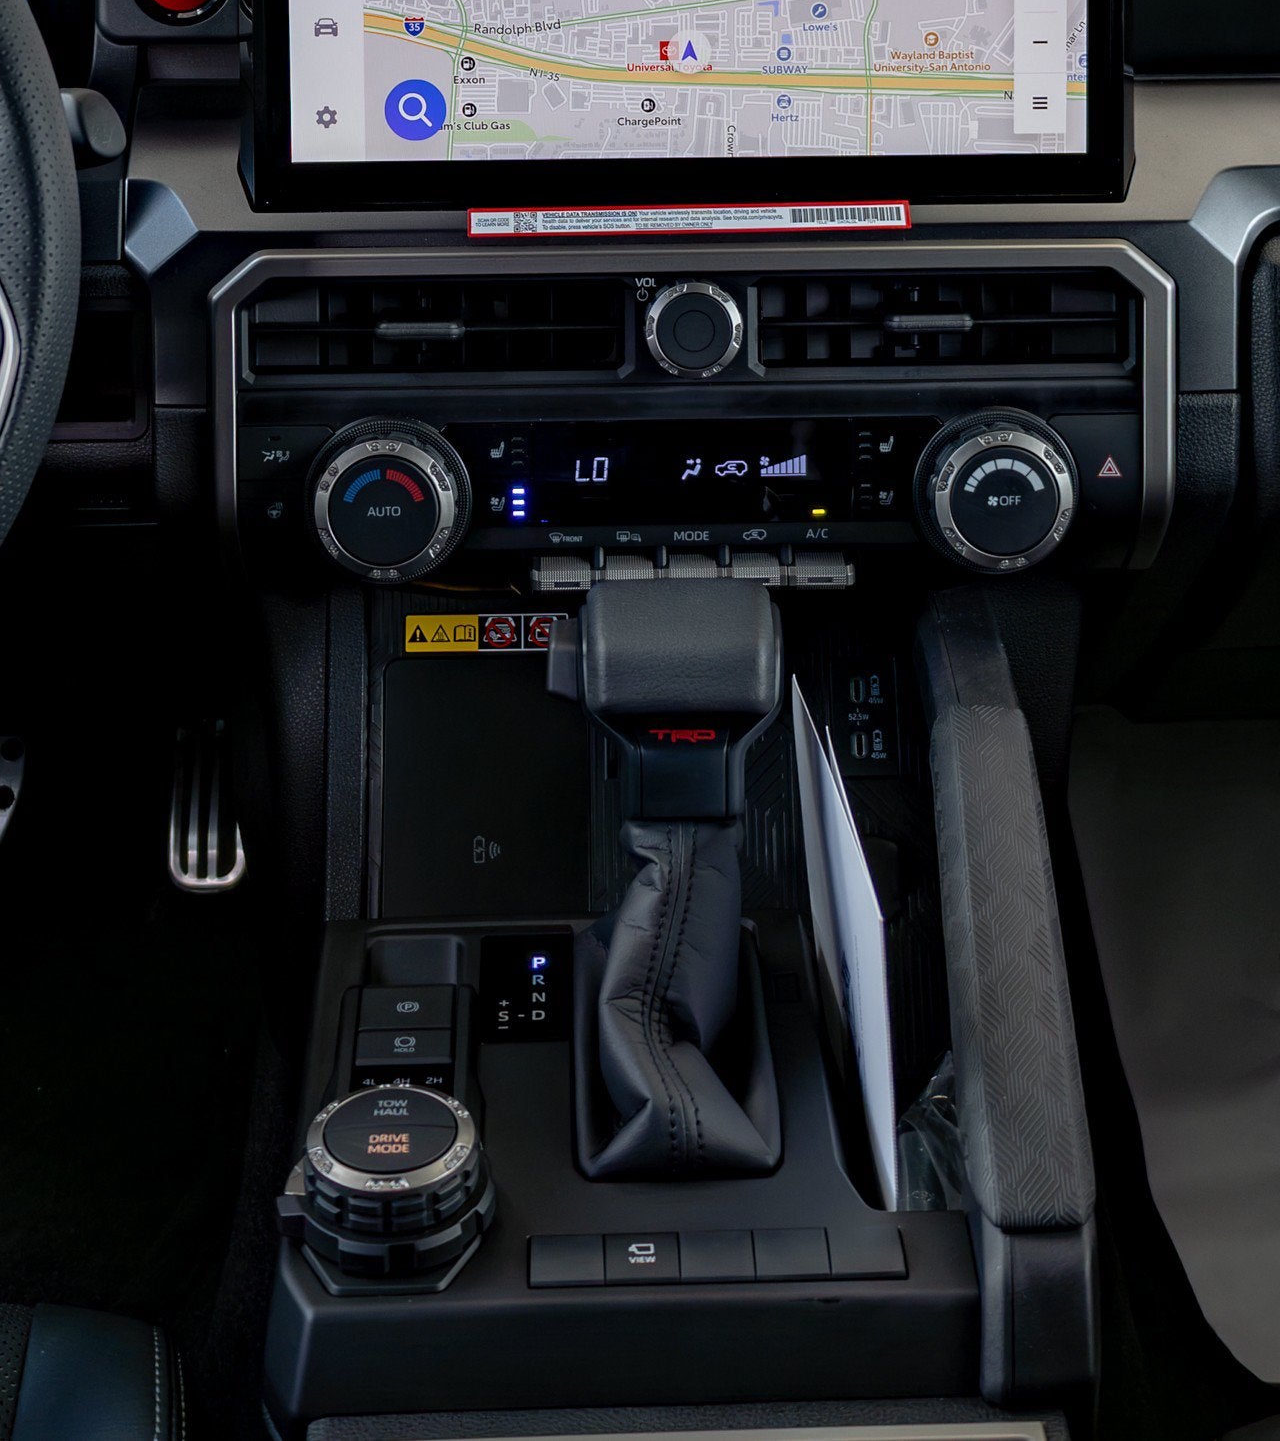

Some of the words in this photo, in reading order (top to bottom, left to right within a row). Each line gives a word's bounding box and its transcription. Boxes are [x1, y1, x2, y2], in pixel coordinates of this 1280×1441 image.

[408, 23, 421, 32] 35
[474, 22, 533, 36] Randolph
[535, 19, 562, 32] Blvd
[802, 23, 838, 32] Lowe's
[890, 51, 936, 61] Wayland
[938, 50, 975, 61] Baptist
[627, 63, 675, 72] Universal
[676, 63, 713, 73] Toyota
[762, 66, 808, 75] SUBWAY
[873, 63, 944, 74] University-San
[946, 62, 991, 72] Antonio
[453, 76, 486, 85] Exxon
[617, 117, 682, 128] ChargePoint
[771, 113, 799, 122] Hertz
[464, 122, 486, 131] Club
[489, 122, 511, 131] Gas
[635, 277, 656, 288] VOL
[574, 456, 610, 482] LO
[999, 495, 1022, 507] OFF
[367, 505, 401, 517] AUTO
[562, 534, 583, 543] FRONT
[673, 530, 709, 542] MODE
[806, 528, 828, 539] A/C
[648, 729, 716, 743] TRD
[532, 956, 546, 969] P
[532, 974, 545, 985] R
[532, 992, 546, 1003] N
[531, 1010, 546, 1021] D
[373, 1108, 409, 1116] HAUL
[369, 1133, 410, 1143] DRIVE
[367, 1144, 410, 1154] MODE
[628, 1256, 656, 1264] VIEW
